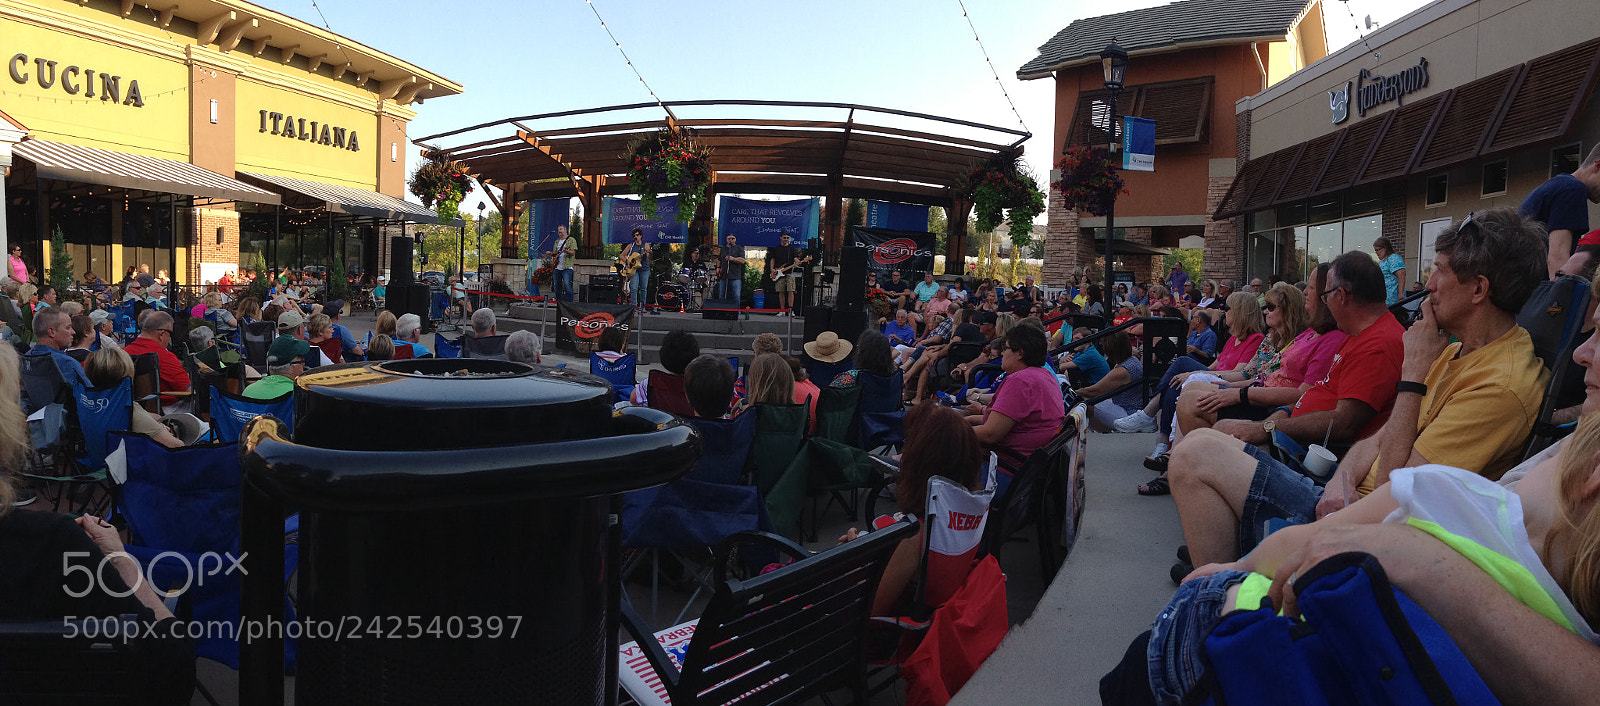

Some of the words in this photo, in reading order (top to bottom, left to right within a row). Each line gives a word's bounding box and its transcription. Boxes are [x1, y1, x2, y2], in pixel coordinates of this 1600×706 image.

[8, 53, 145, 108] CUCINA
[258, 109, 360, 152] ITALIANA
[769, 208, 803, 217] REVOLVES
